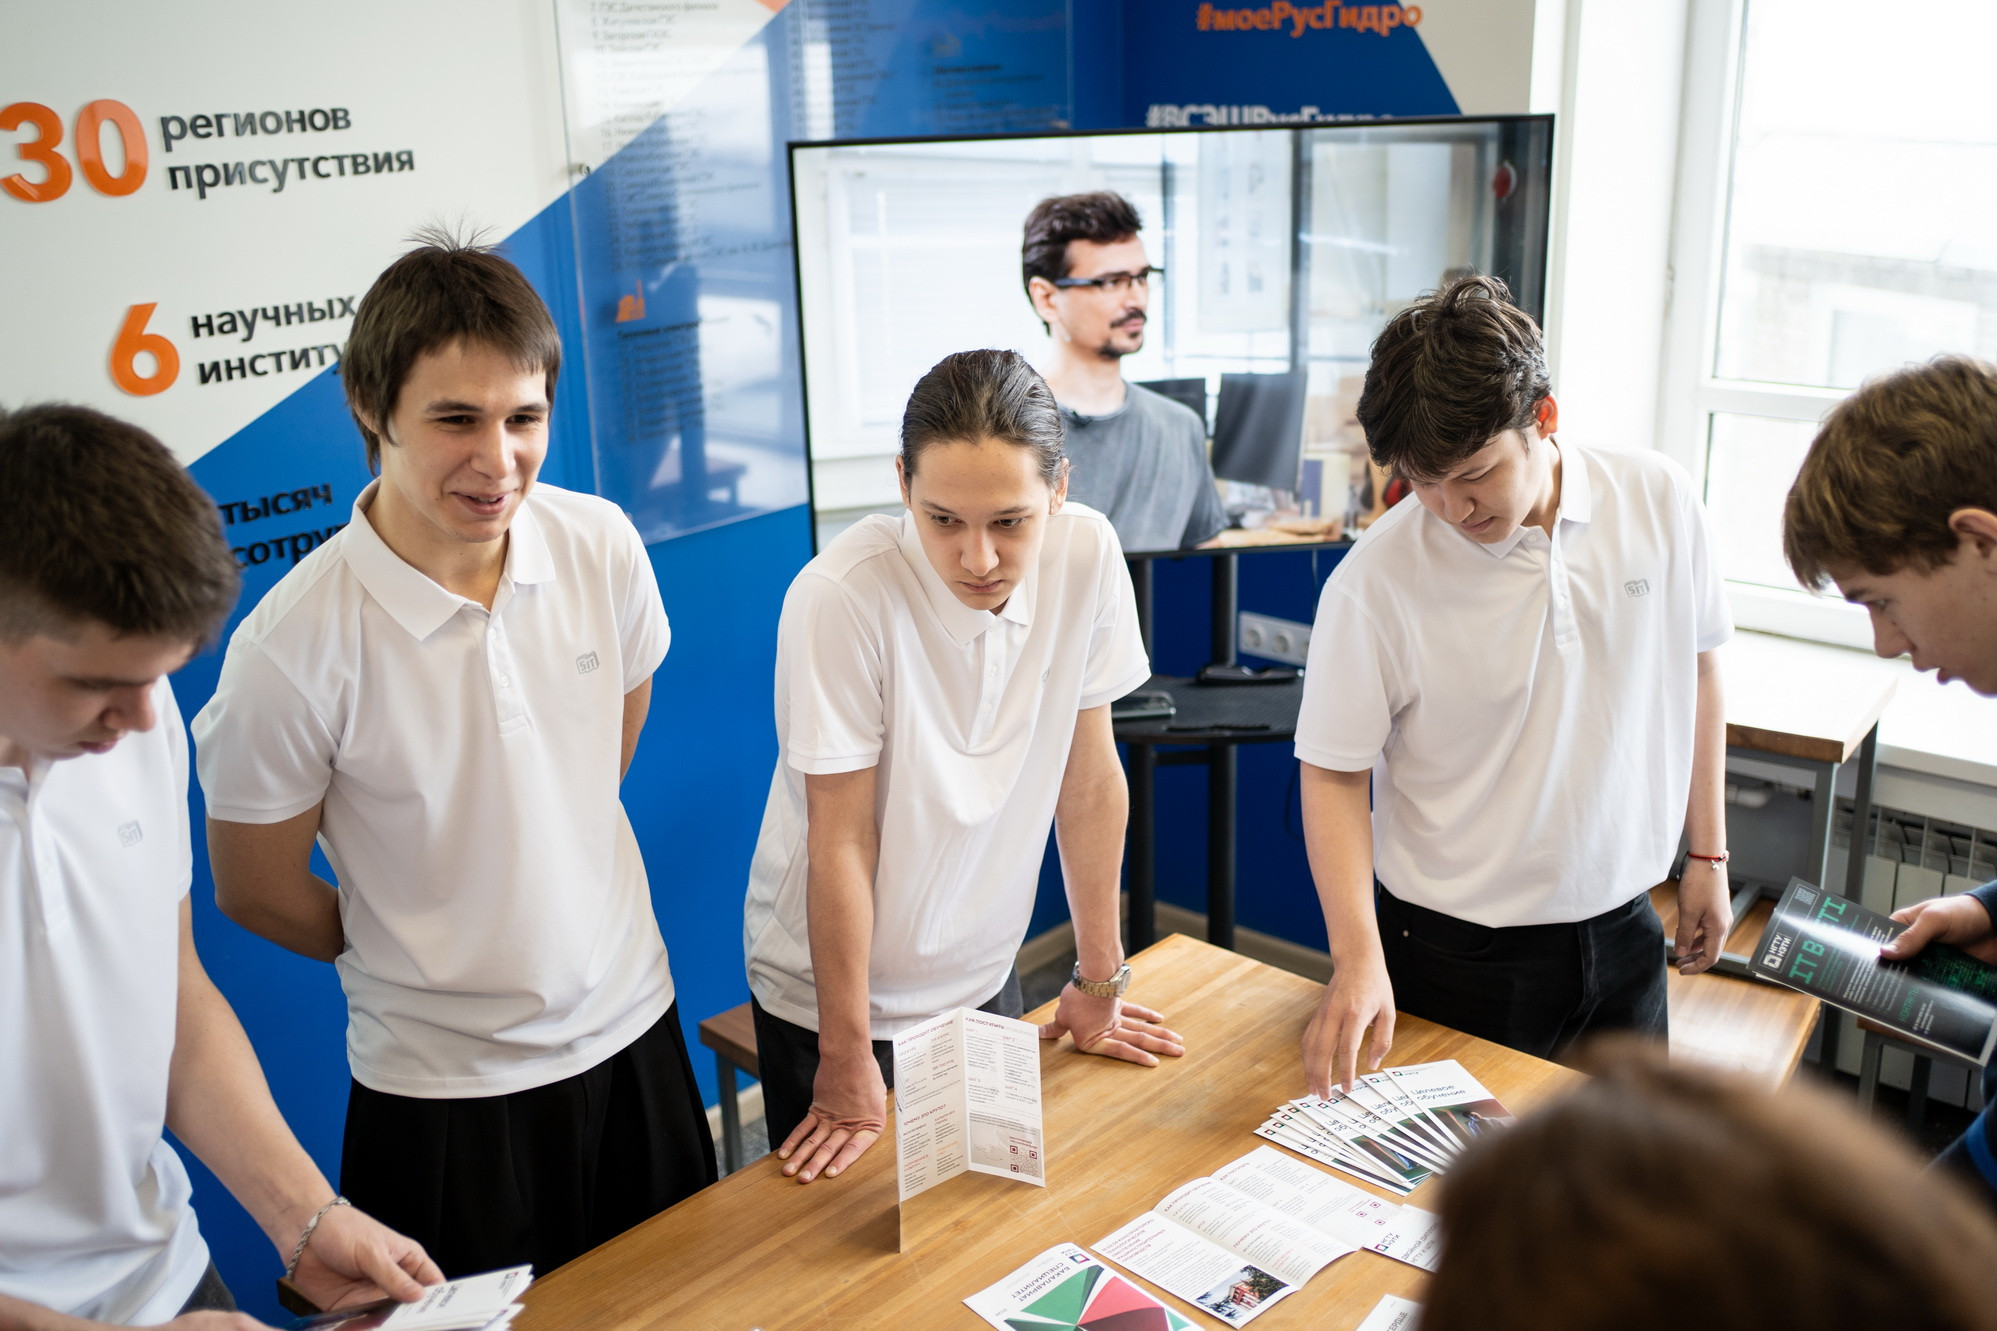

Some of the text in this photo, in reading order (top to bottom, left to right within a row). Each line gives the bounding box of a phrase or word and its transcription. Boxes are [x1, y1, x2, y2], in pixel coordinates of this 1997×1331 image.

[1196, 0, 1423, 38] #моеРусГидро
[161, 107, 352, 152] регионов
[0, 99, 149, 202] 30
[168, 149, 415, 199] присутствия
[190, 296, 357, 343] научных
[111, 302, 180, 396] 6
[218, 483, 333, 526] тысяч
[1769, 934, 1782, 954] НГТУ
[1778, 936, 1793, 959] НЭТИ
[1410, 1085, 1455, 1095] Целевое
[1417, 1090, 1466, 1100] обучение
[1012, 1262, 1064, 1298] СПЕЦИАЛИТЕТ
[1019, 1266, 1070, 1302] БАКАЛАВРИАТ
